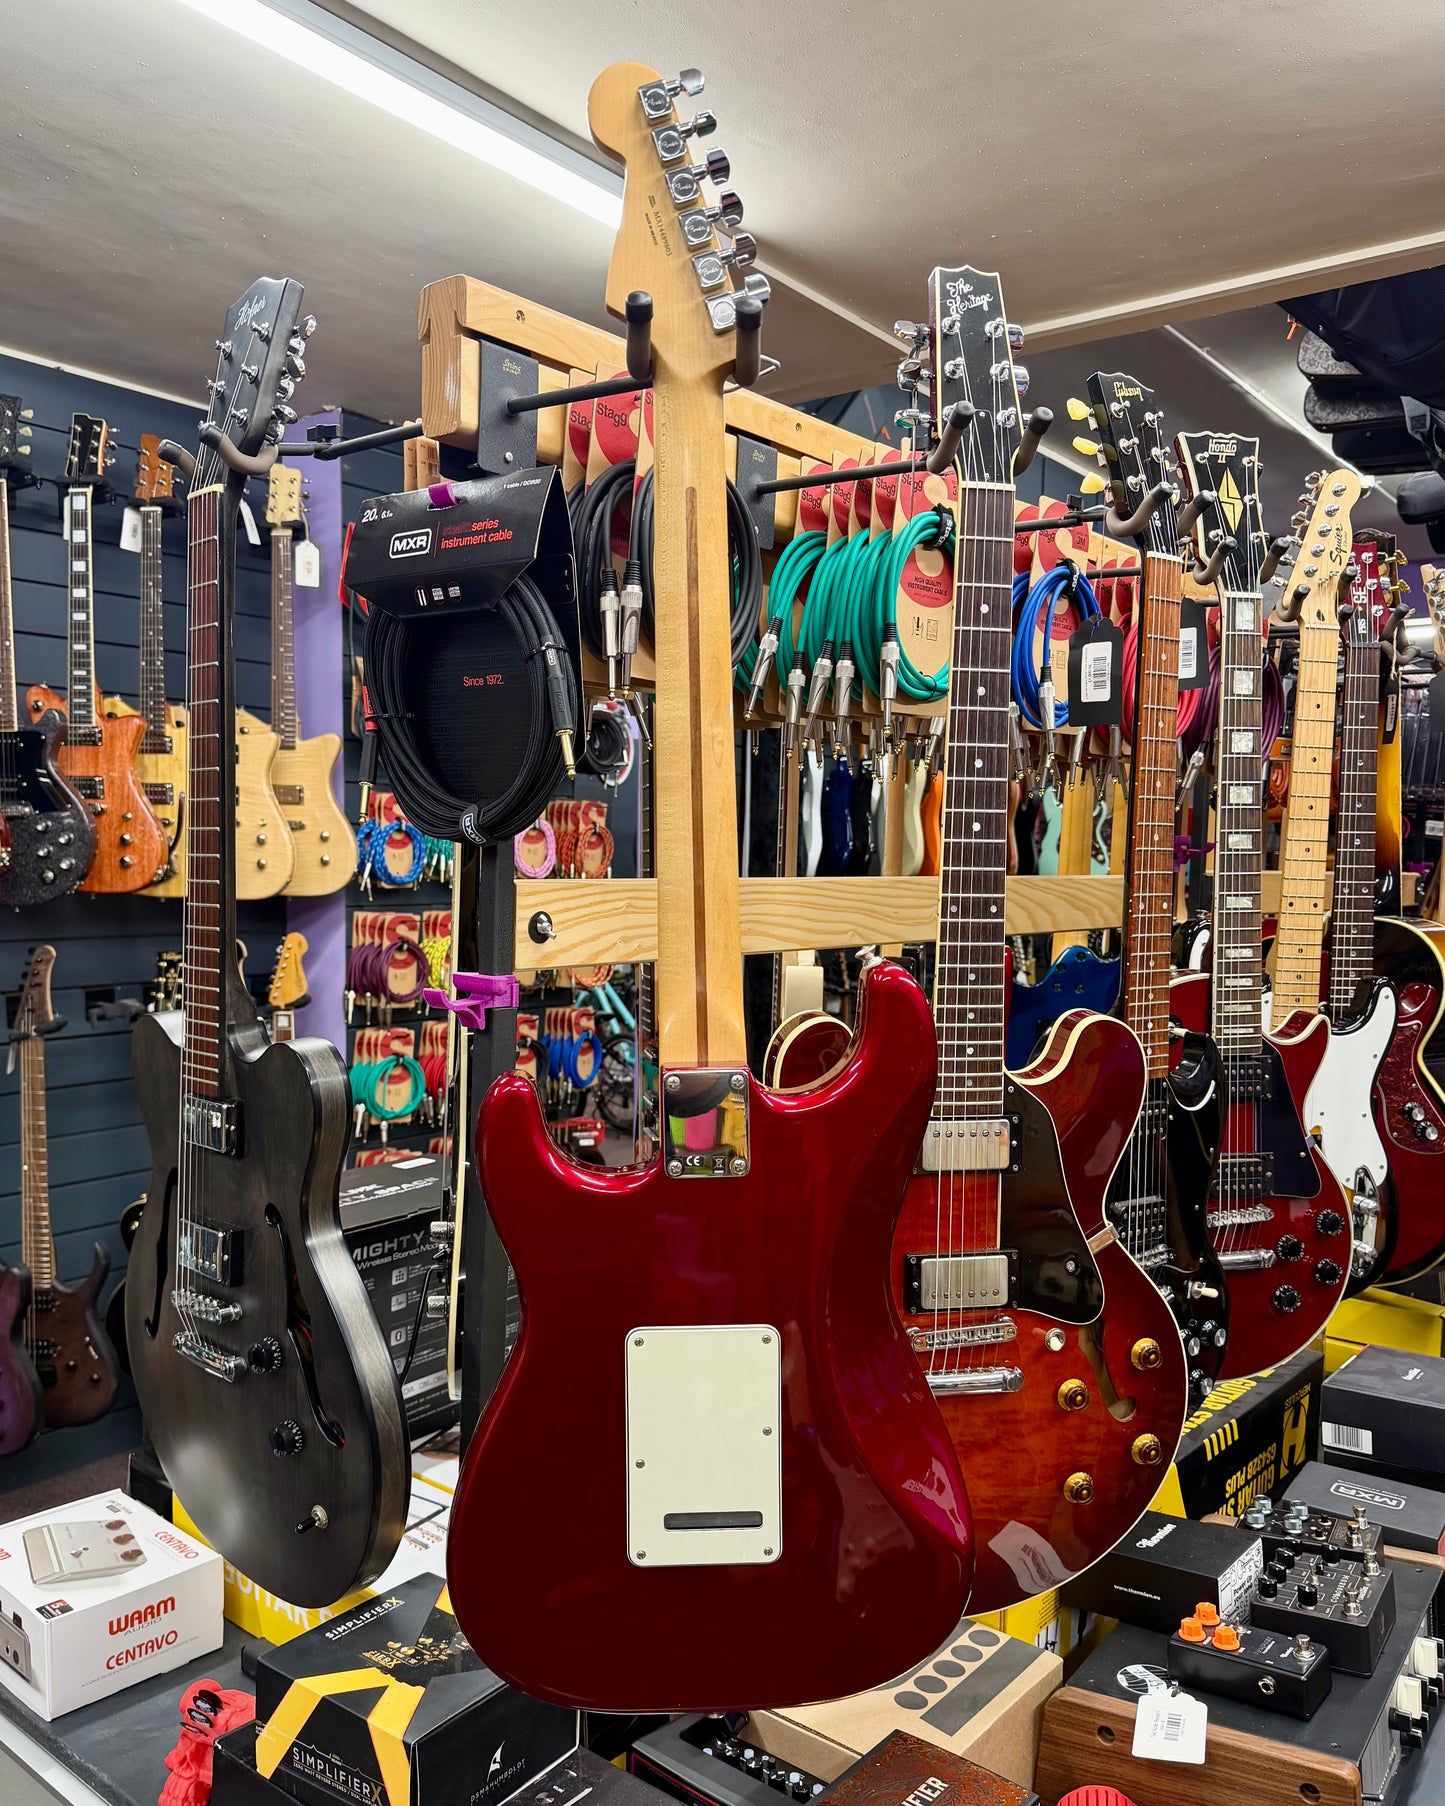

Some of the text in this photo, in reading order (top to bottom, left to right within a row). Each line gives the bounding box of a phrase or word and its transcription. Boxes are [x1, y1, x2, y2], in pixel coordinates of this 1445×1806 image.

[946, 278, 974, 298] The
[946, 294, 994, 315] Heritage
[1113, 381, 1144, 402] Gibson
[596, 403, 628, 428] Stagg
[1208, 438, 1237, 456] Hondo
[834, 484, 852, 505] Stagg
[876, 477, 896, 498] Stagg
[801, 489, 822, 510] Stagg
[471, 518, 499, 532] series
[393, 534, 428, 552] MXR
[440, 528, 513, 550] instrument cable
[1329, 523, 1348, 566] Squier
[1354, 563, 1362, 584] ONE
[1353, 586, 1368, 604] SE
[463, 676, 484, 687] Since
[464, 814, 482, 844] MXR
[352, 1231, 425, 1261] MIGHTY
[357, 1254, 392, 1270] Wireless
[393, 1247, 420, 1259] Stereo
[1225, 1442, 1277, 1499] GS432B PLUS
[1337, 1485, 1398, 1507] MXR
[155, 1531, 199, 1559] CENTAVO
[109, 1596, 176, 1636] WARM
[124, 1617, 162, 1637] AUDIO
[105, 1630, 179, 1671] CENTAVO
[331, 1780, 347, 1794] STEREO
